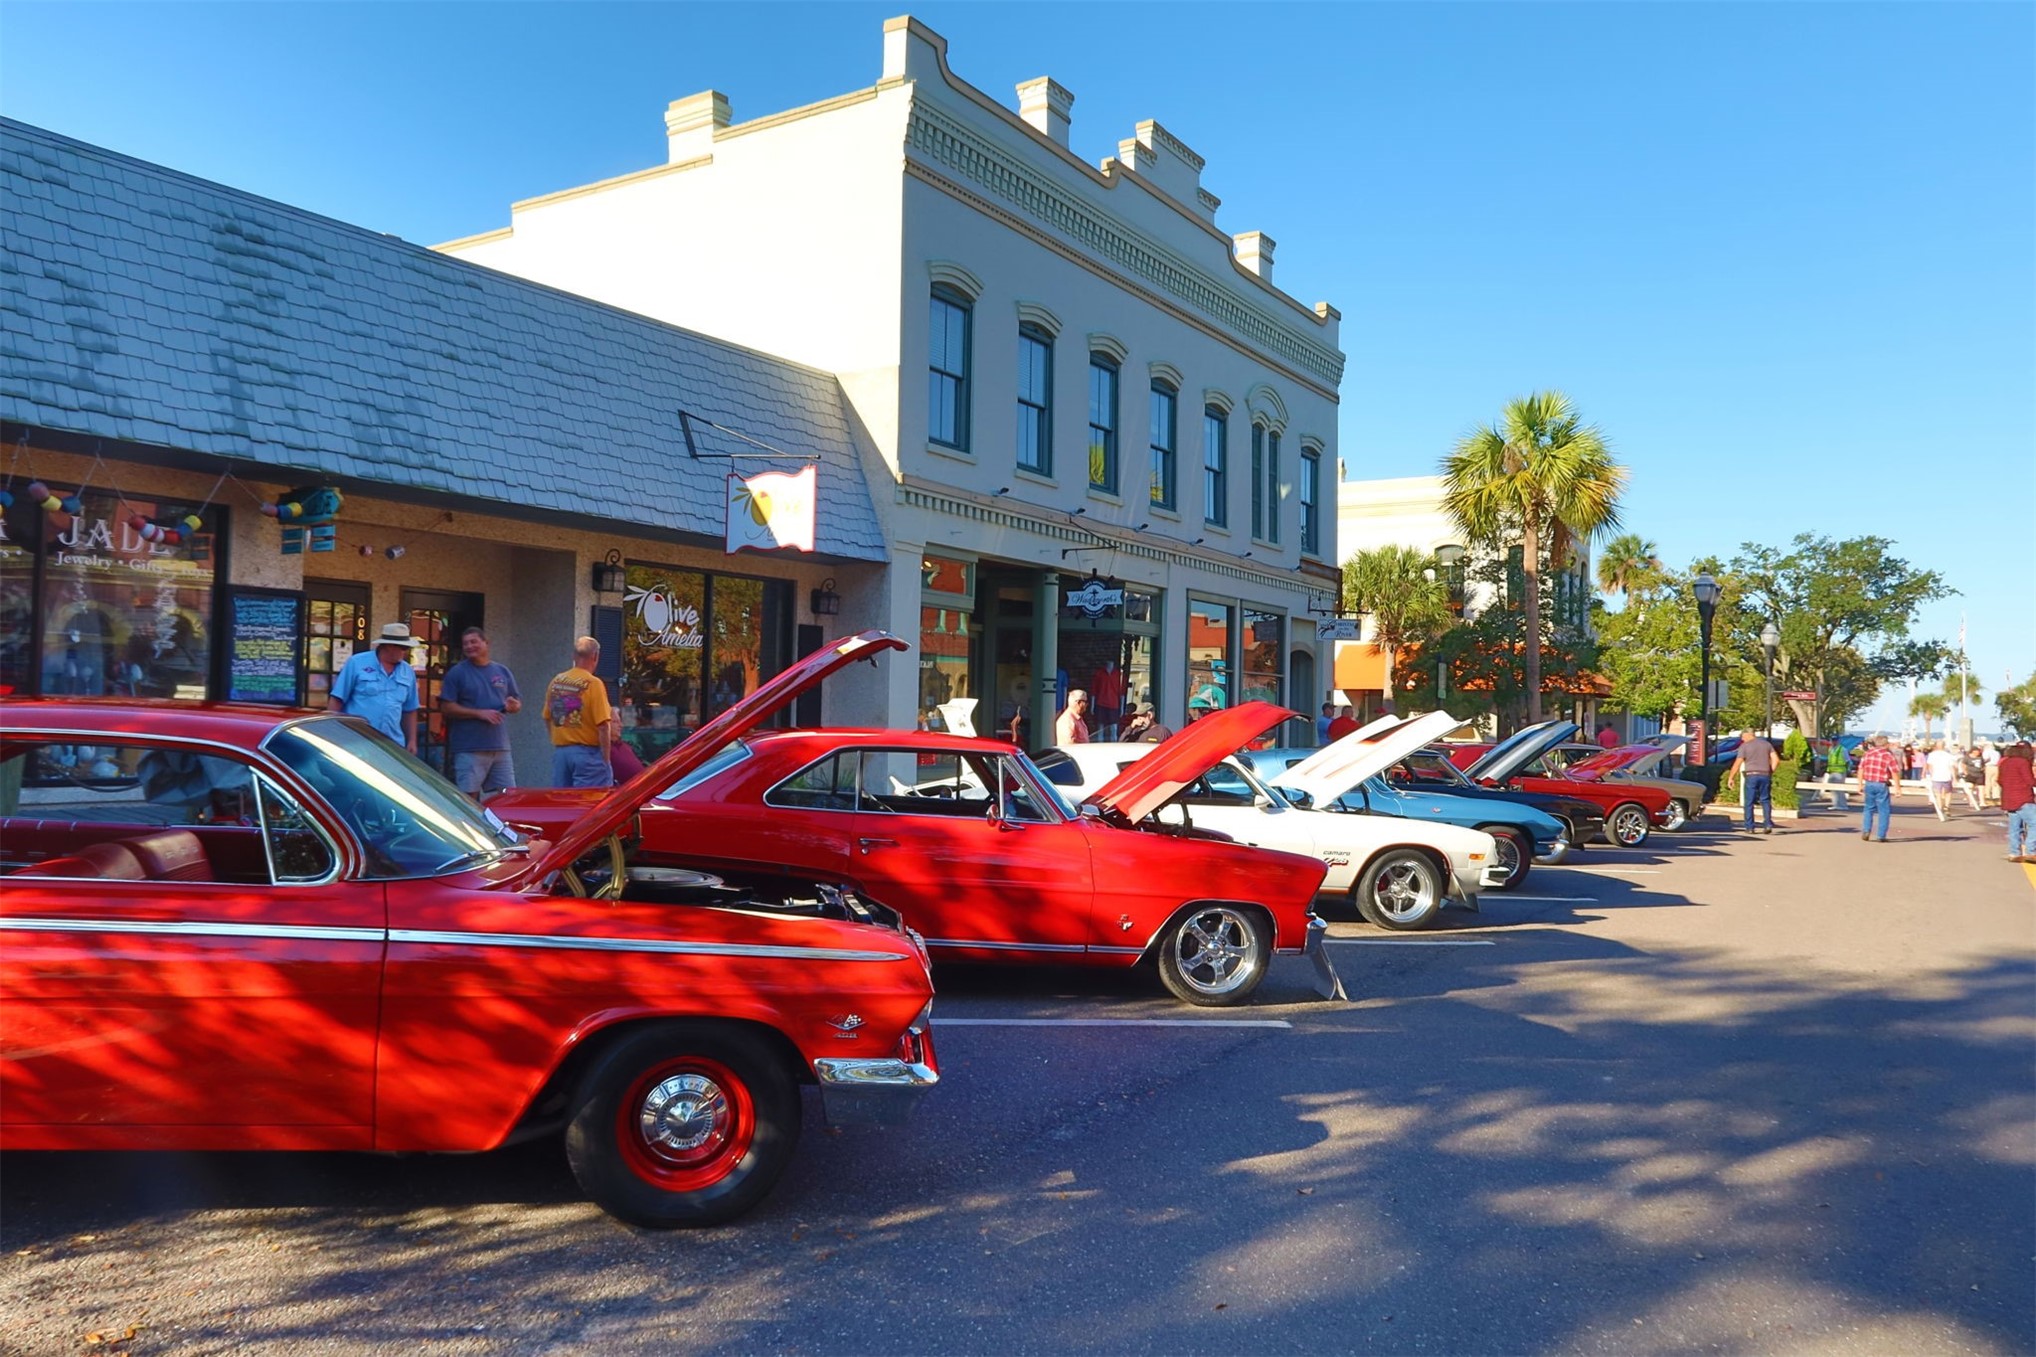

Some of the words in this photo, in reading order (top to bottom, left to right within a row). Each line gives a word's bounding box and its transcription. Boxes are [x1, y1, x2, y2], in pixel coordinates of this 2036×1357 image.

[55, 551, 113, 570] Jewelry
[357, 605, 366, 640] 208
[644, 592, 700, 632] Olive
[638, 624, 704, 647] Amelia
